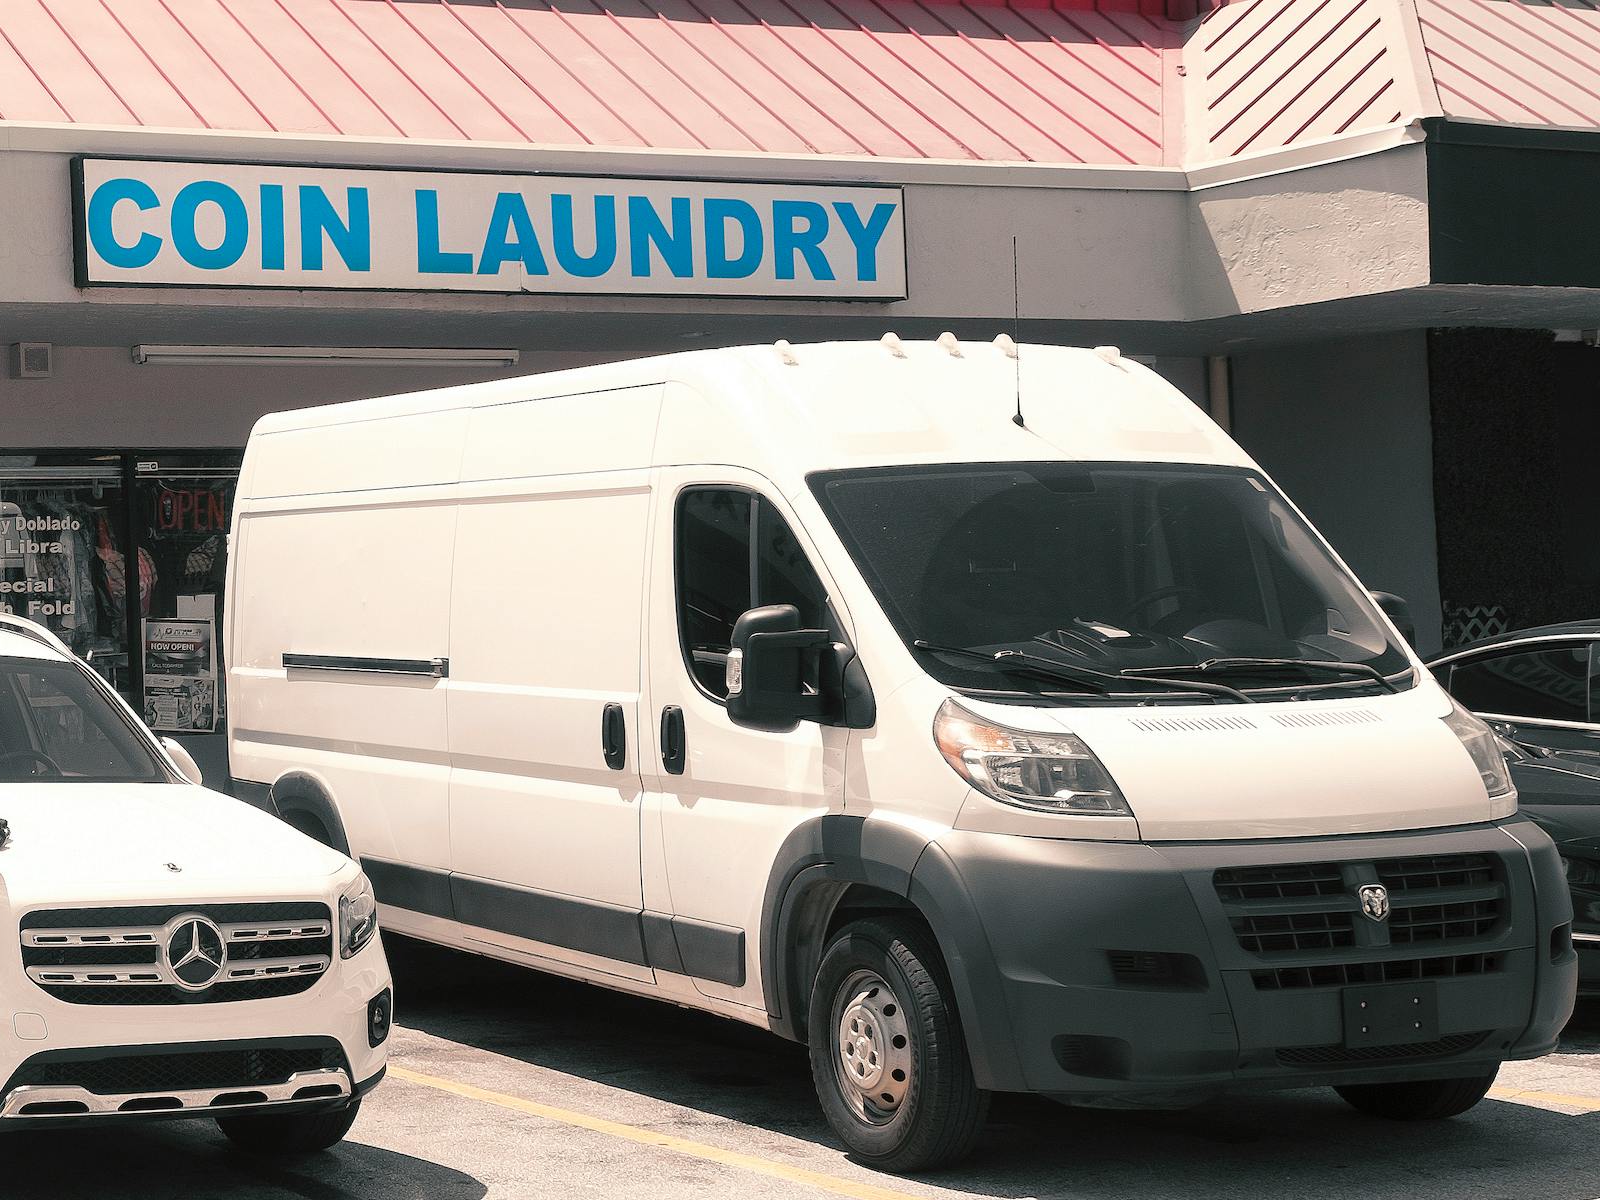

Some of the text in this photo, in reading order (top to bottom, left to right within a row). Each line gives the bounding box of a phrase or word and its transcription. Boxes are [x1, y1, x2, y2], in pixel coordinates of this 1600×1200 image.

[87, 178, 897, 282] COIN LAUNDRY
[160, 489, 225, 531] OPEN
[1, 519, 11, 535] y
[15, 515, 81, 531] Doblado
[5, 539, 64, 554] Libra
[28, 600, 76, 616] Fold
[150, 642, 195, 652] NOW OPEN!
